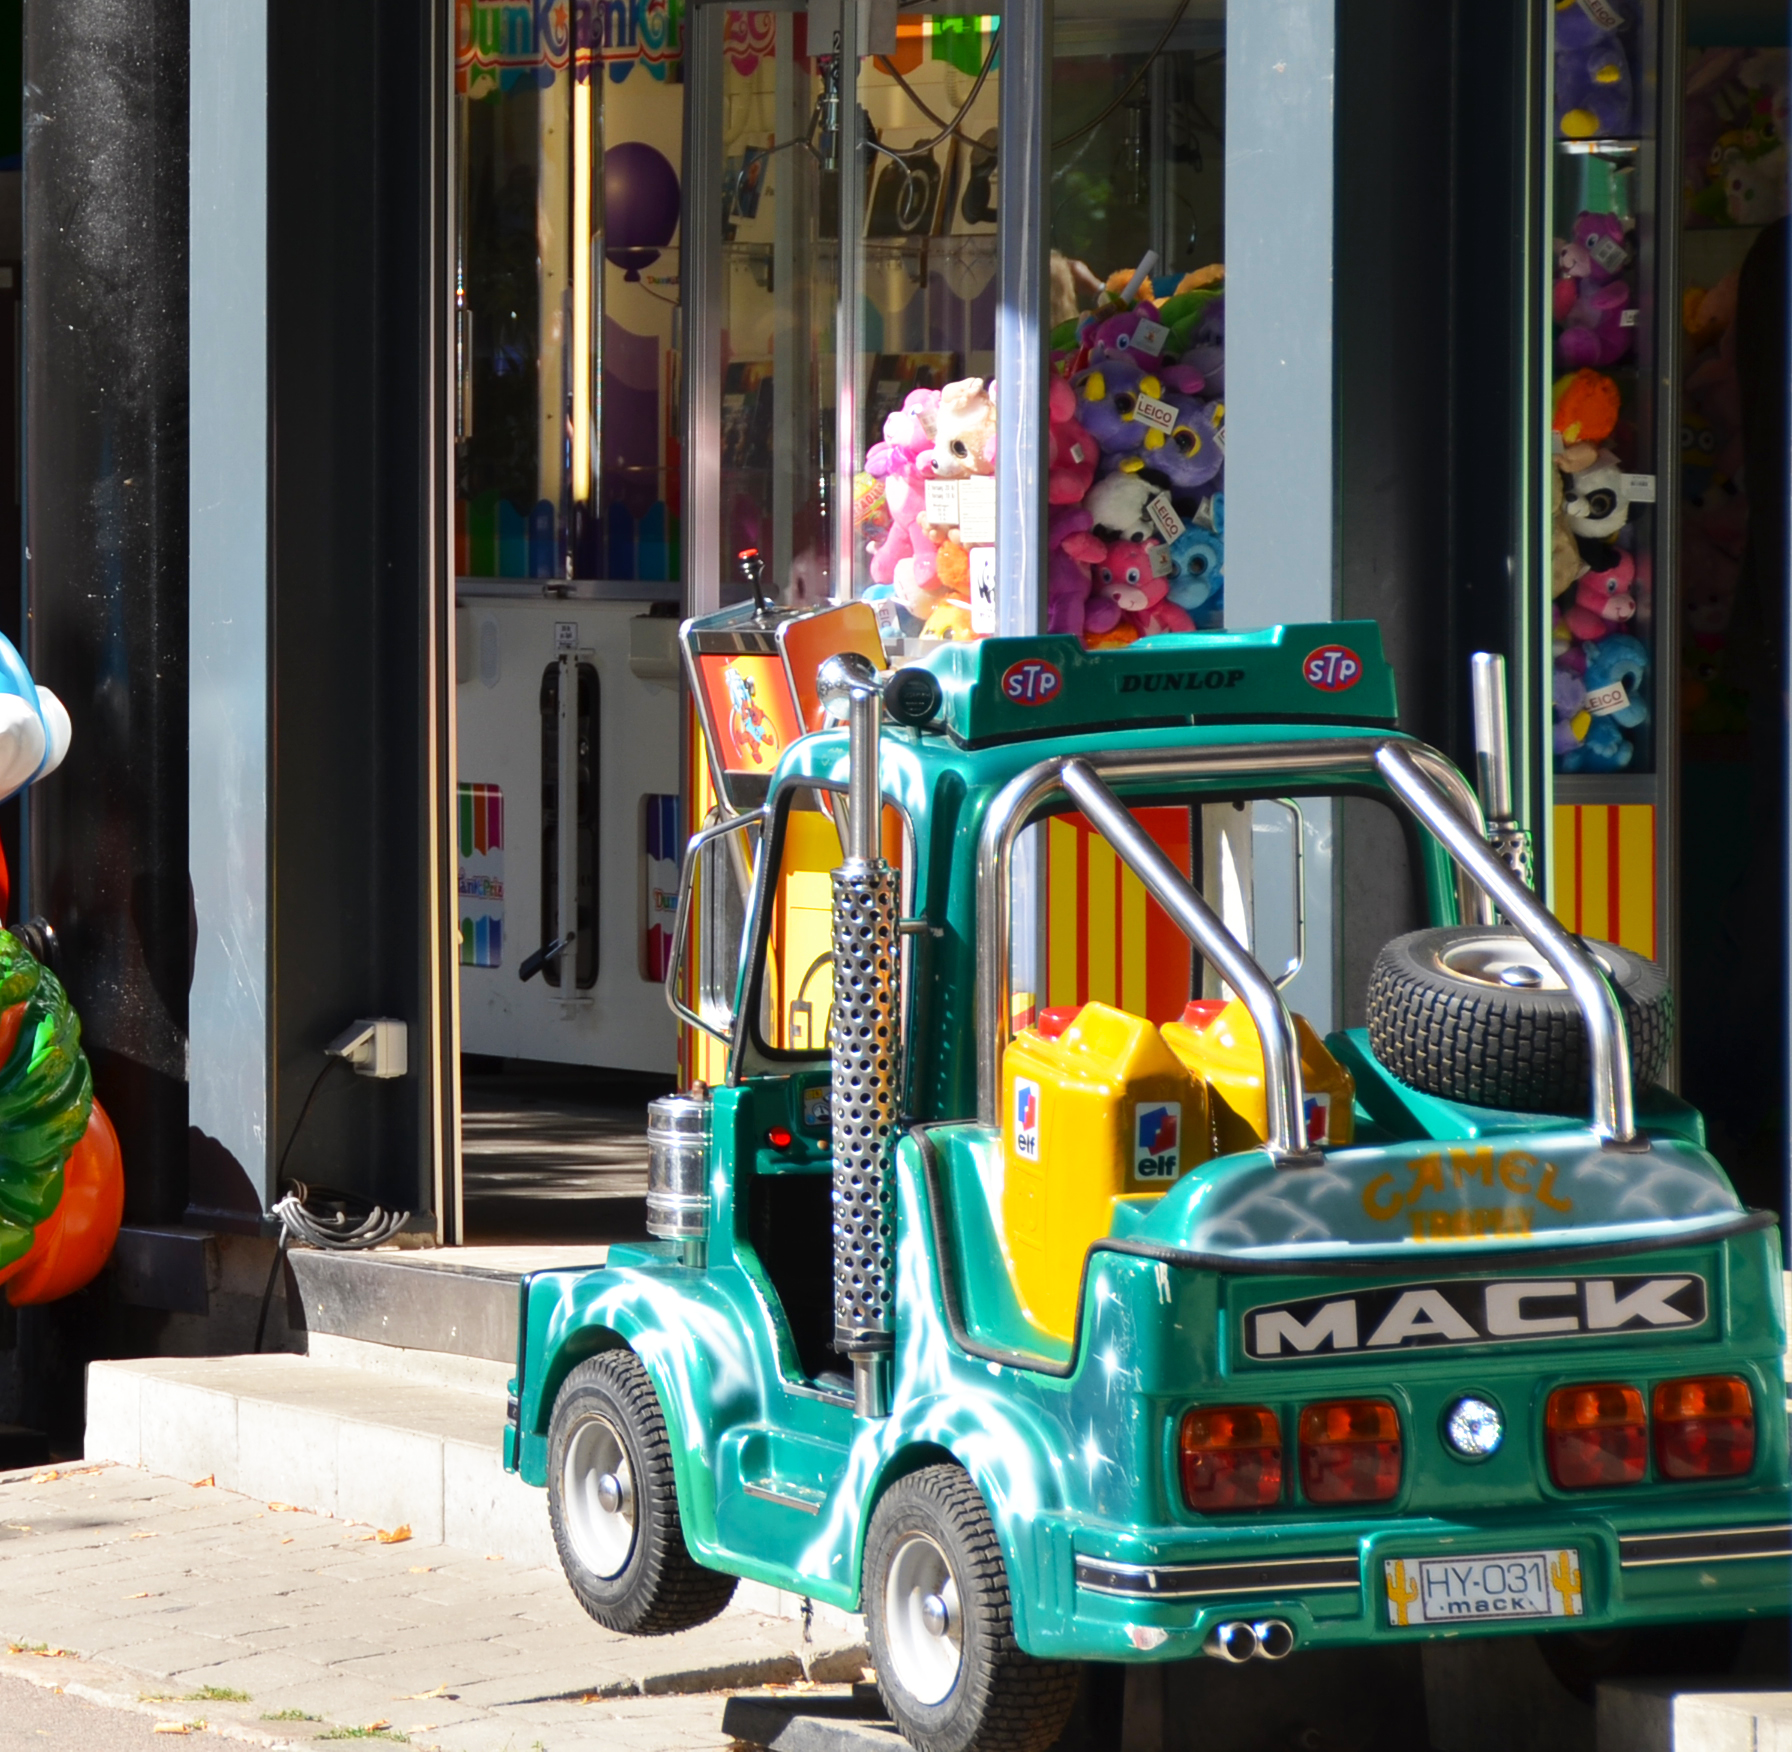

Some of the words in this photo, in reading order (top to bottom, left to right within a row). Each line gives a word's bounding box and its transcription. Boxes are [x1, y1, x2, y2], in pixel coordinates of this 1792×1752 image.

[1137, 402, 1173, 424] LEICO
[1153, 499, 1179, 536] LEICO
[1007, 665, 1056, 698] STP
[1120, 670, 1245, 694] DUNLOP
[1309, 652, 1357, 684] STP
[1017, 1133, 1036, 1155] elf
[1138, 1154, 1177, 1177] elf
[1361, 1145, 1574, 1221] CAMEL
[1406, 1207, 1534, 1244] TROPHY
[1255, 1279, 1695, 1357] MACK
[1426, 1562, 1543, 1599] HY-031
